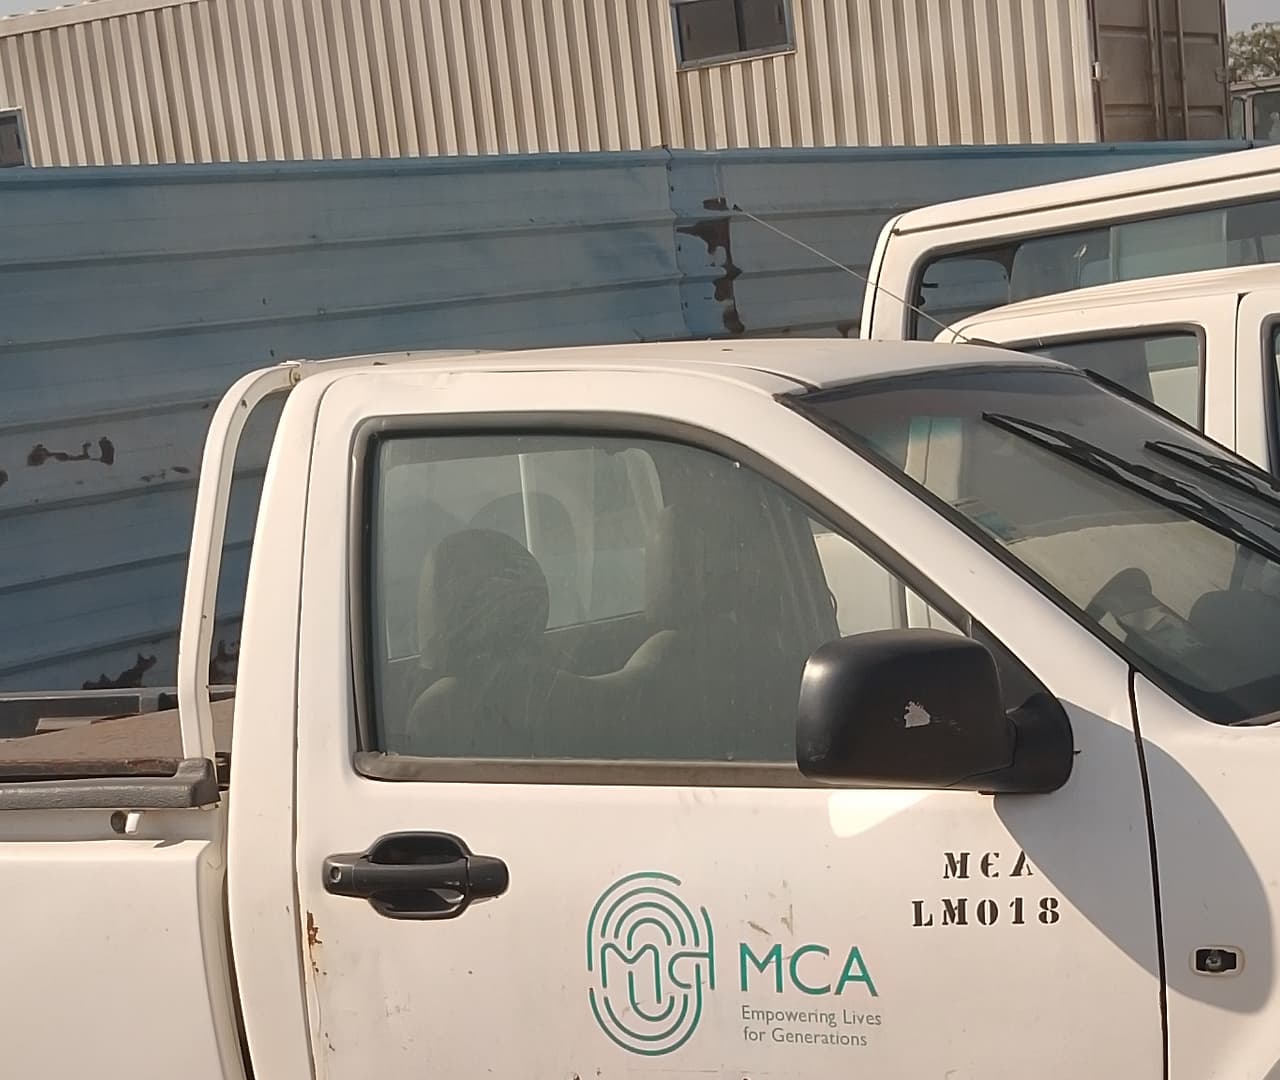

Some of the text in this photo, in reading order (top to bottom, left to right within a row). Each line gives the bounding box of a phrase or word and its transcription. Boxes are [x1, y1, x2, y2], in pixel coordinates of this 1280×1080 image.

[739, 942, 878, 997] MCA
[741, 1005, 882, 1026] Empowering Lives
[743, 1026, 868, 1047] for Generations
